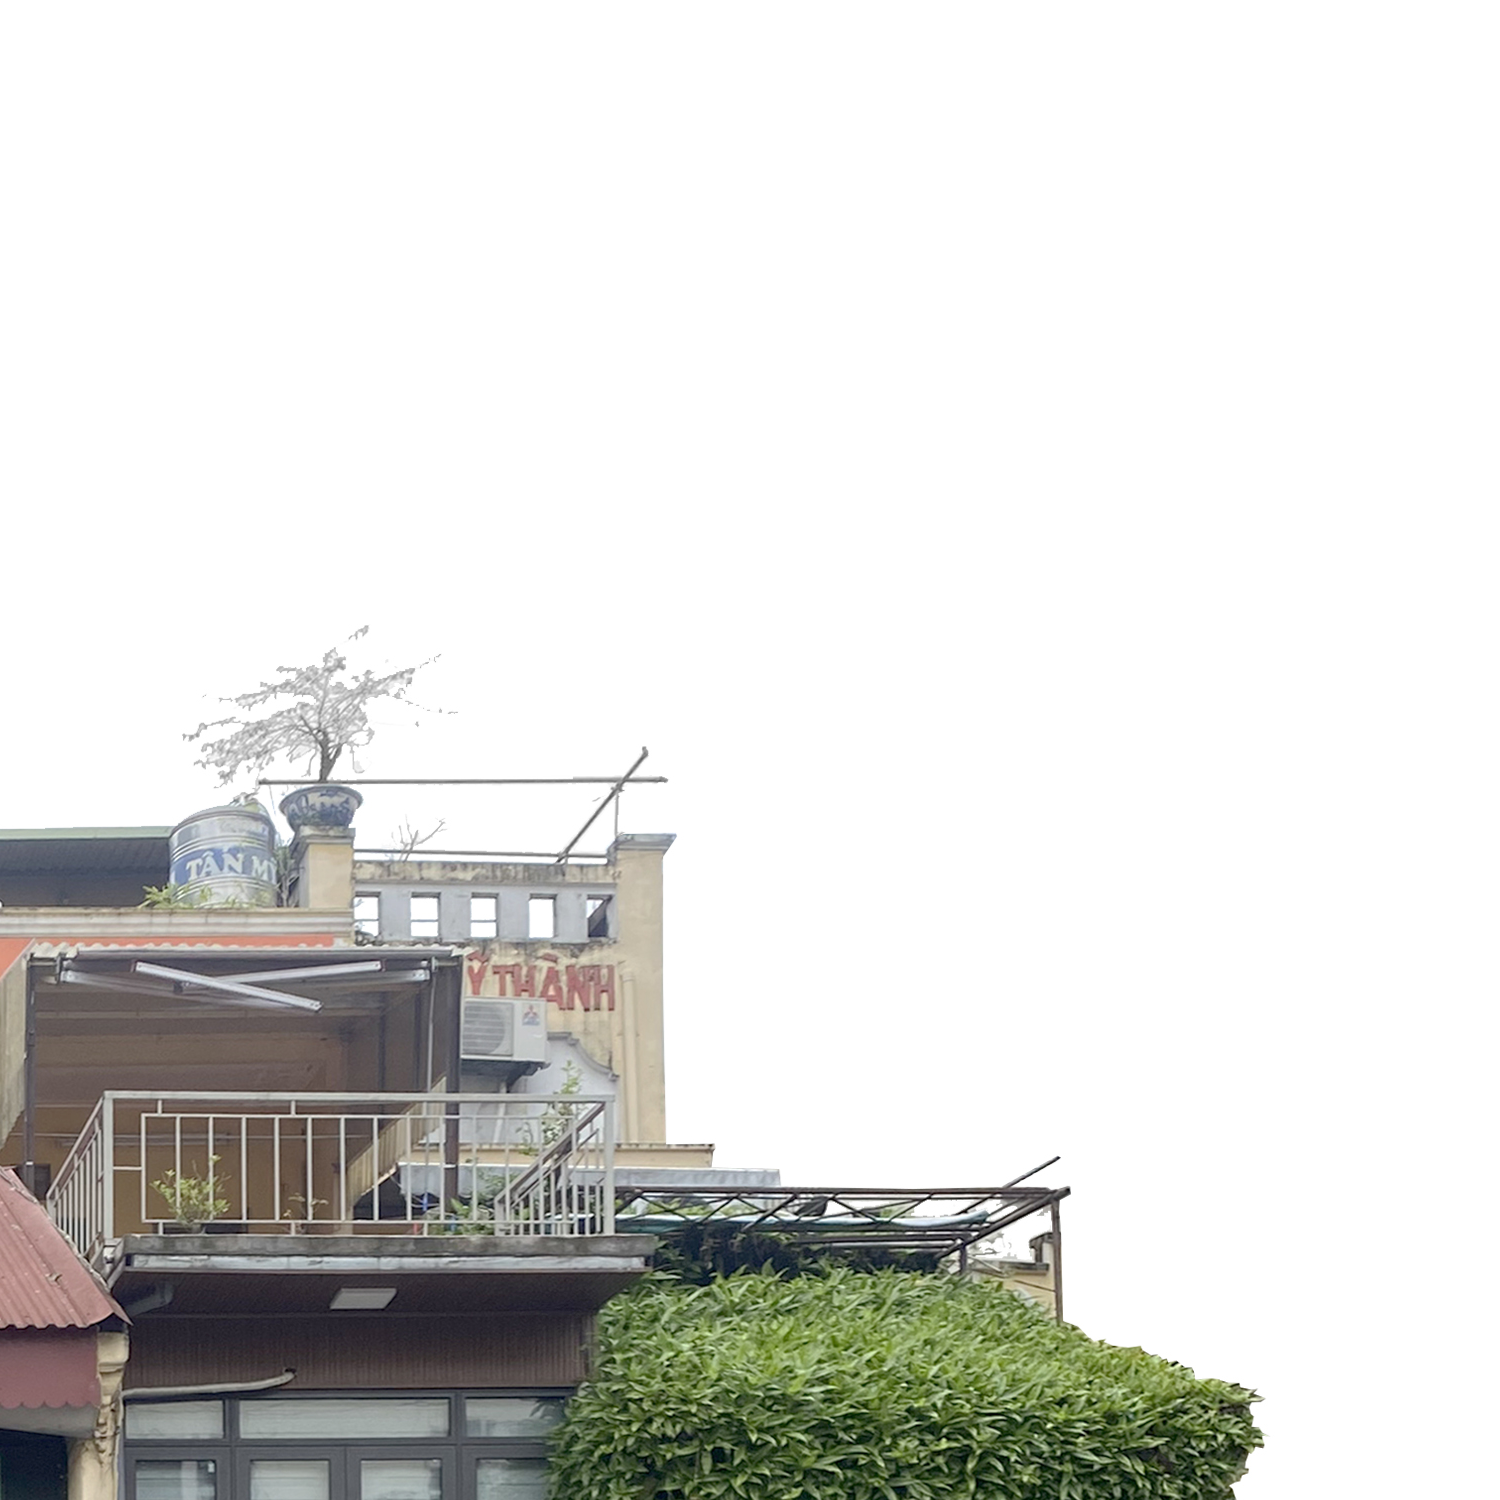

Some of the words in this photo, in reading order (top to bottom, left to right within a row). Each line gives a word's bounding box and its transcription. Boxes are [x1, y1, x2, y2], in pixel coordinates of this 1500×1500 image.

[186, 850, 245, 881] TÂN
[466, 951, 492, 996] Ỹ
[492, 953, 615, 1012] THÀNH
